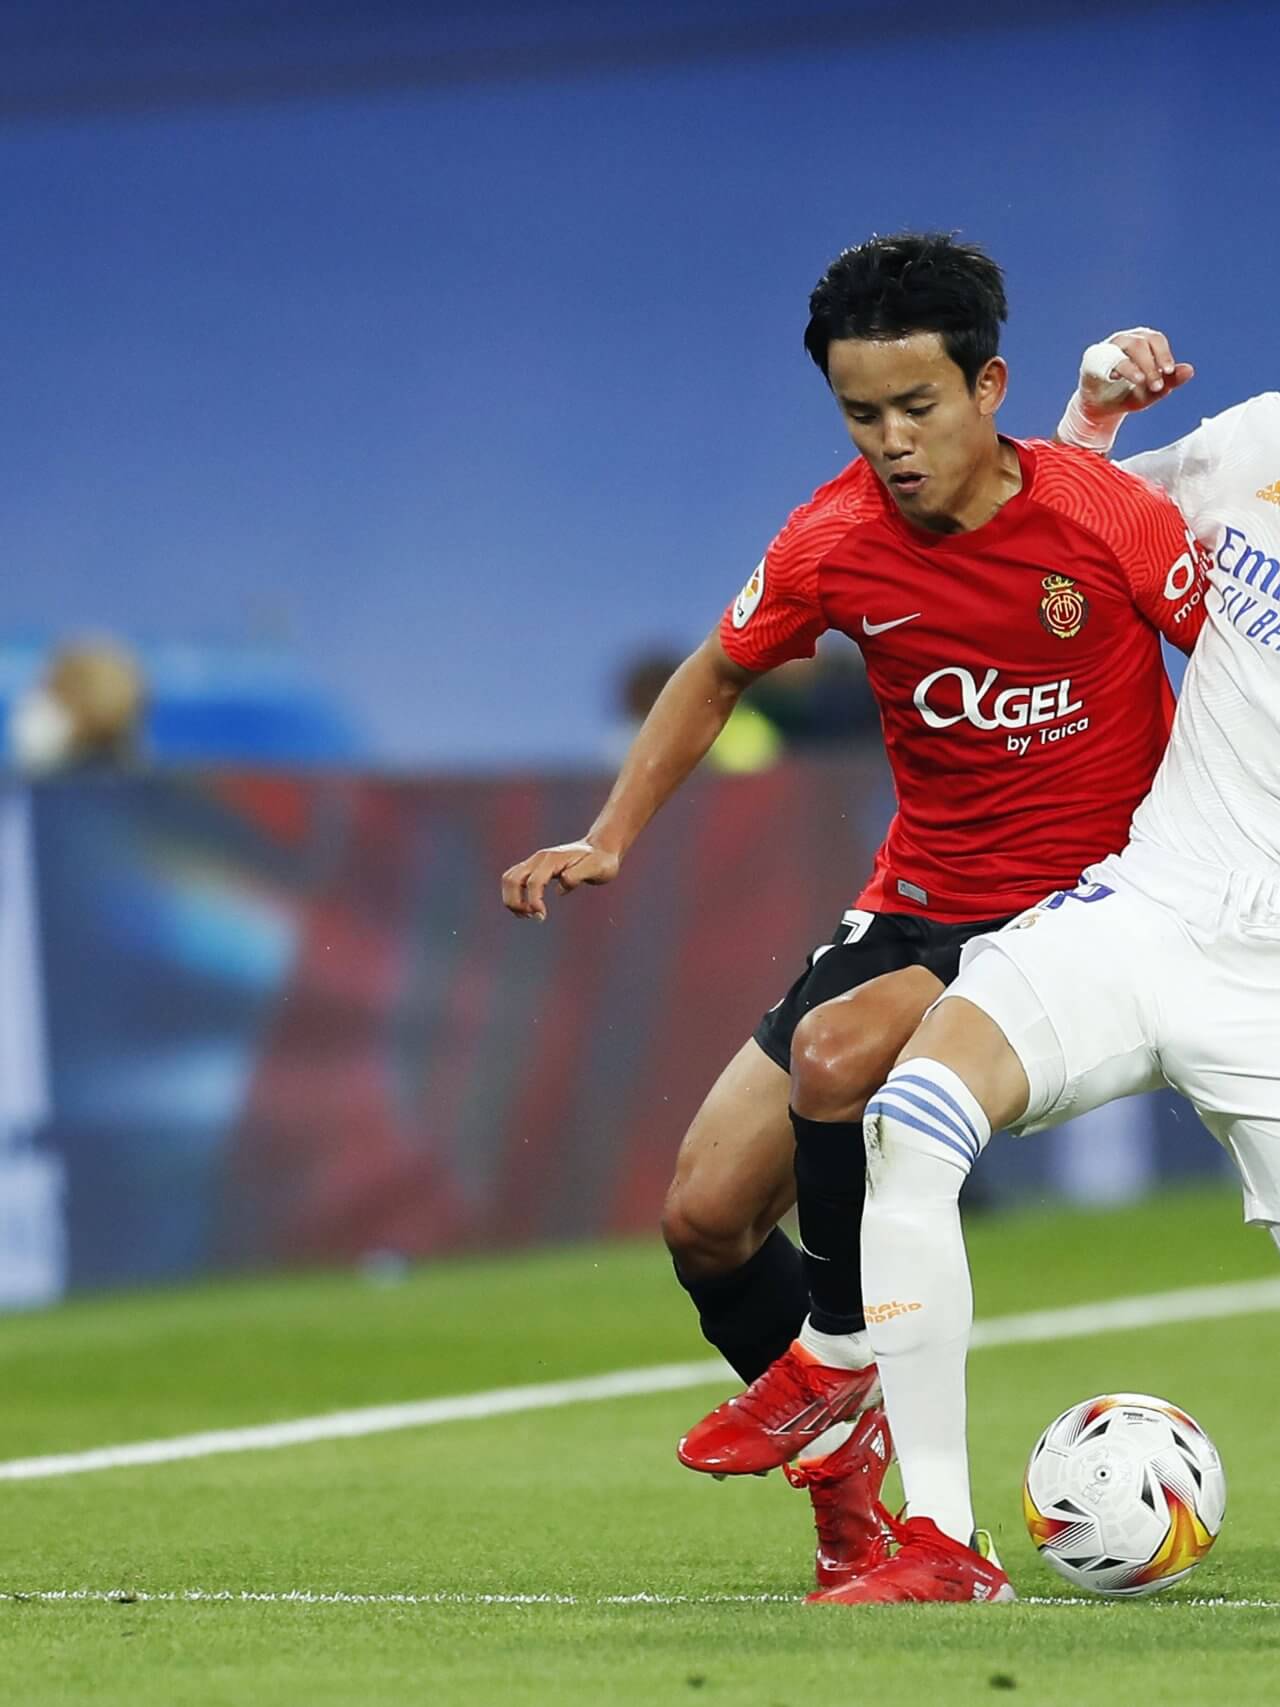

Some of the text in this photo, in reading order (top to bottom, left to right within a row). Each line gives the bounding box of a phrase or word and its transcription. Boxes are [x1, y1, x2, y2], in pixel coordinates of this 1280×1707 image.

[1006, 718, 1089, 756] by Taica
[864, 1301, 904, 1315] EAL
[865, 1302, 923, 1325] ADRID
